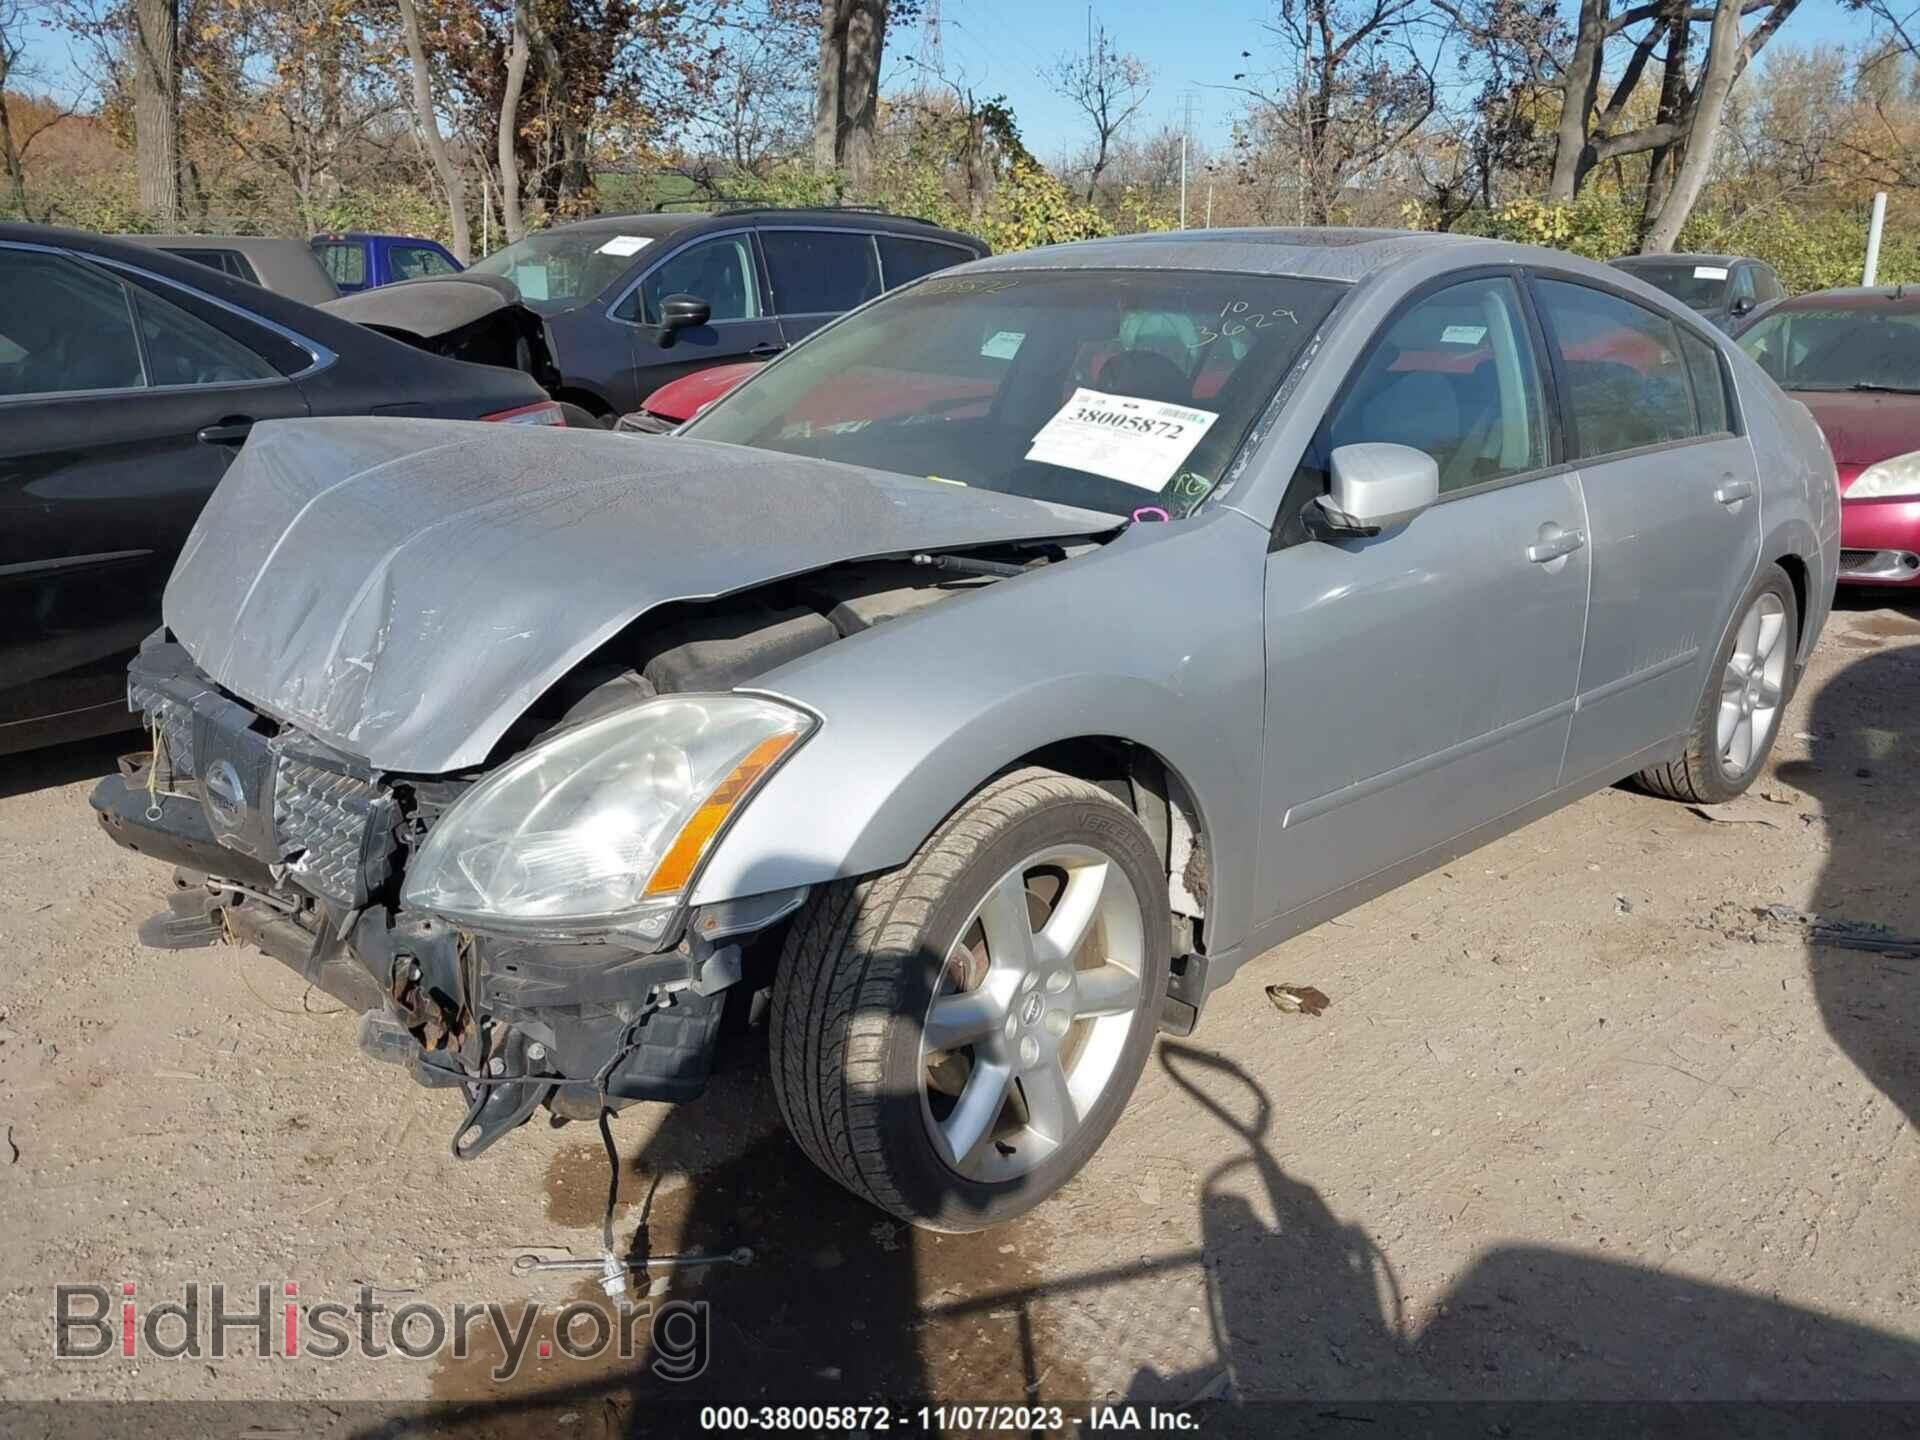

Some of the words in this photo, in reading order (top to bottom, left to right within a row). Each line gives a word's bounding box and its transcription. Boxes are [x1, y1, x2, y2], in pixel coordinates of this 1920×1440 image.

[1220, 300, 1249, 318] 10
[1186, 308, 1299, 349] 3629
[1067, 407, 1185, 440] 38005872
